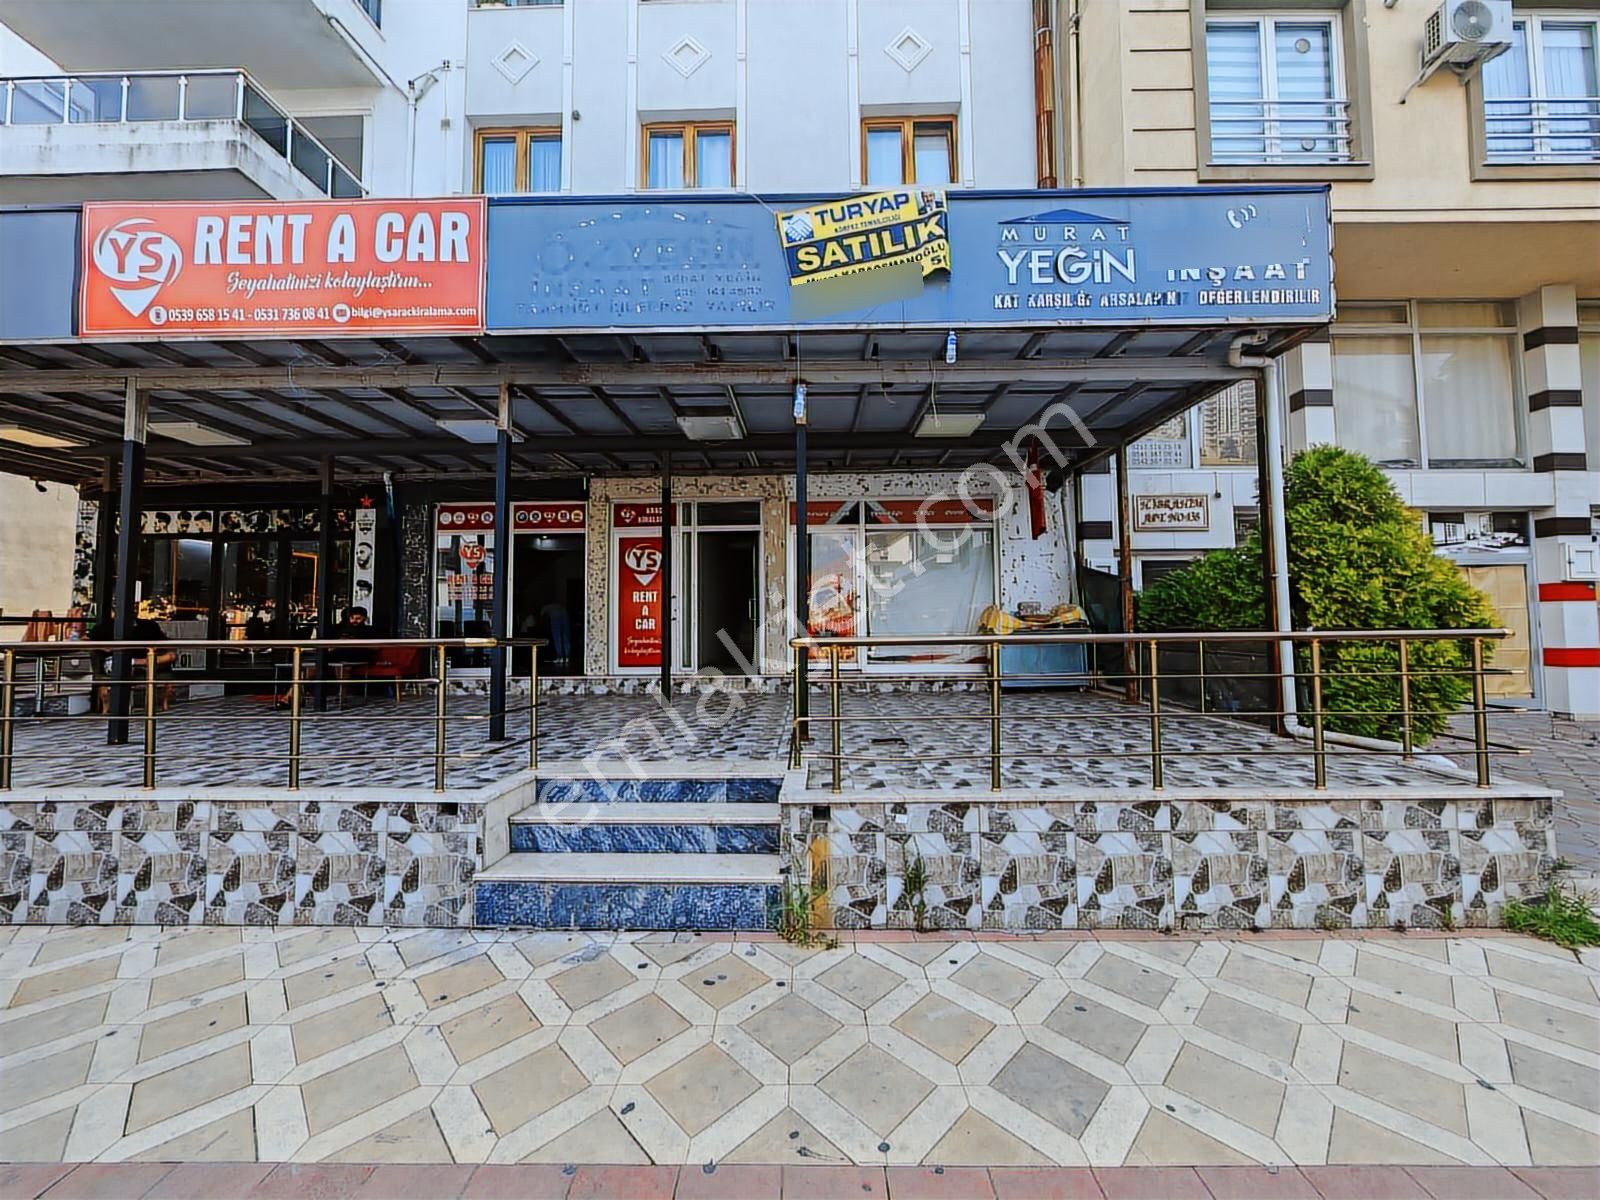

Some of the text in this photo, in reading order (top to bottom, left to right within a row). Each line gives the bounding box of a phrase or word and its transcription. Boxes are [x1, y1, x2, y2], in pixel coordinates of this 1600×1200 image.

[814, 192, 910, 226] TURYAP
[193, 211, 470, 265] RENT A CAR
[1001, 226, 1130, 241] MURAT
[796, 214, 946, 272] SATILIK
[108, 236, 163, 274] YS
[993, 293, 1019, 309] KAT
[168, 307, 194, 322] 0539
[196, 307, 216, 321] 658
[217, 307, 230, 321] 15
[232, 307, 246, 321] 41
[254, 307, 279, 321] 0531
[282, 307, 300, 321] 736
[302, 307, 316, 321] 08
[317, 306, 330, 320] 41
[632, 551, 658, 568] YS
[632, 590, 658, 603] RENT
[641, 604, 649, 616] A
[635, 618, 656, 630] CAR
